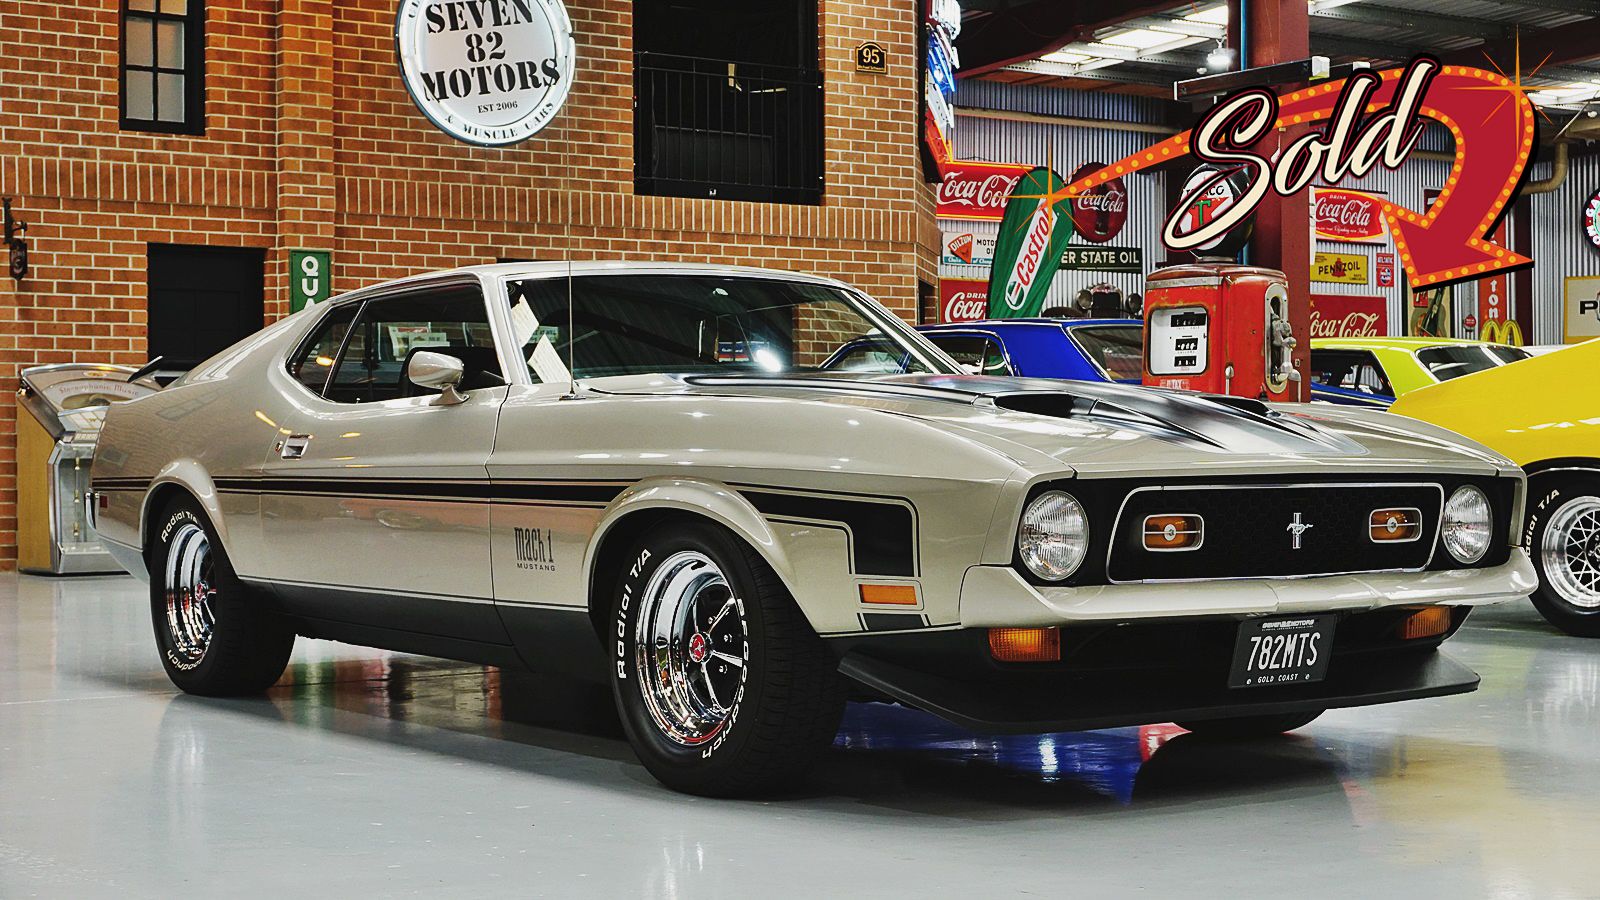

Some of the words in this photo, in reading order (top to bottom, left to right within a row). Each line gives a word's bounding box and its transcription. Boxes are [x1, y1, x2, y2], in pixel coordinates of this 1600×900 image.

[425, 0, 533, 34] SEVEN
[465, 31, 506, 63] 82
[862, 48, 880, 64] 95
[420, 58, 561, 103] MOTORS
[462, 123, 518, 139] MUSCLE
[523, 102, 554, 130] CARS
[477, 104, 495, 114] EST
[497, 100, 518, 111] 2006
[936, 171, 1021, 208] Coca-Col
[1077, 188, 1124, 213] Coca-Cola
[1315, 197, 1372, 226] Coca-Cola
[1016, 205, 1053, 287] Castrol
[1080, 251, 1115, 264] STATE
[1119, 251, 1140, 264] OIL
[1318, 261, 1361, 276] PENNZOIL
[944, 292, 987, 323] Coca-
[161, 511, 185, 543] Radial
[513, 527, 546, 562] mach
[547, 529, 554, 563] 1
[517, 563, 556, 571] MUSTANG
[617, 583, 633, 679] Radial
[629, 548, 651, 578] T/A
[1247, 632, 1320, 671] 782MTS
[1257, 675, 1274, 684] GOLD
[1278, 673, 1299, 682] COAST
